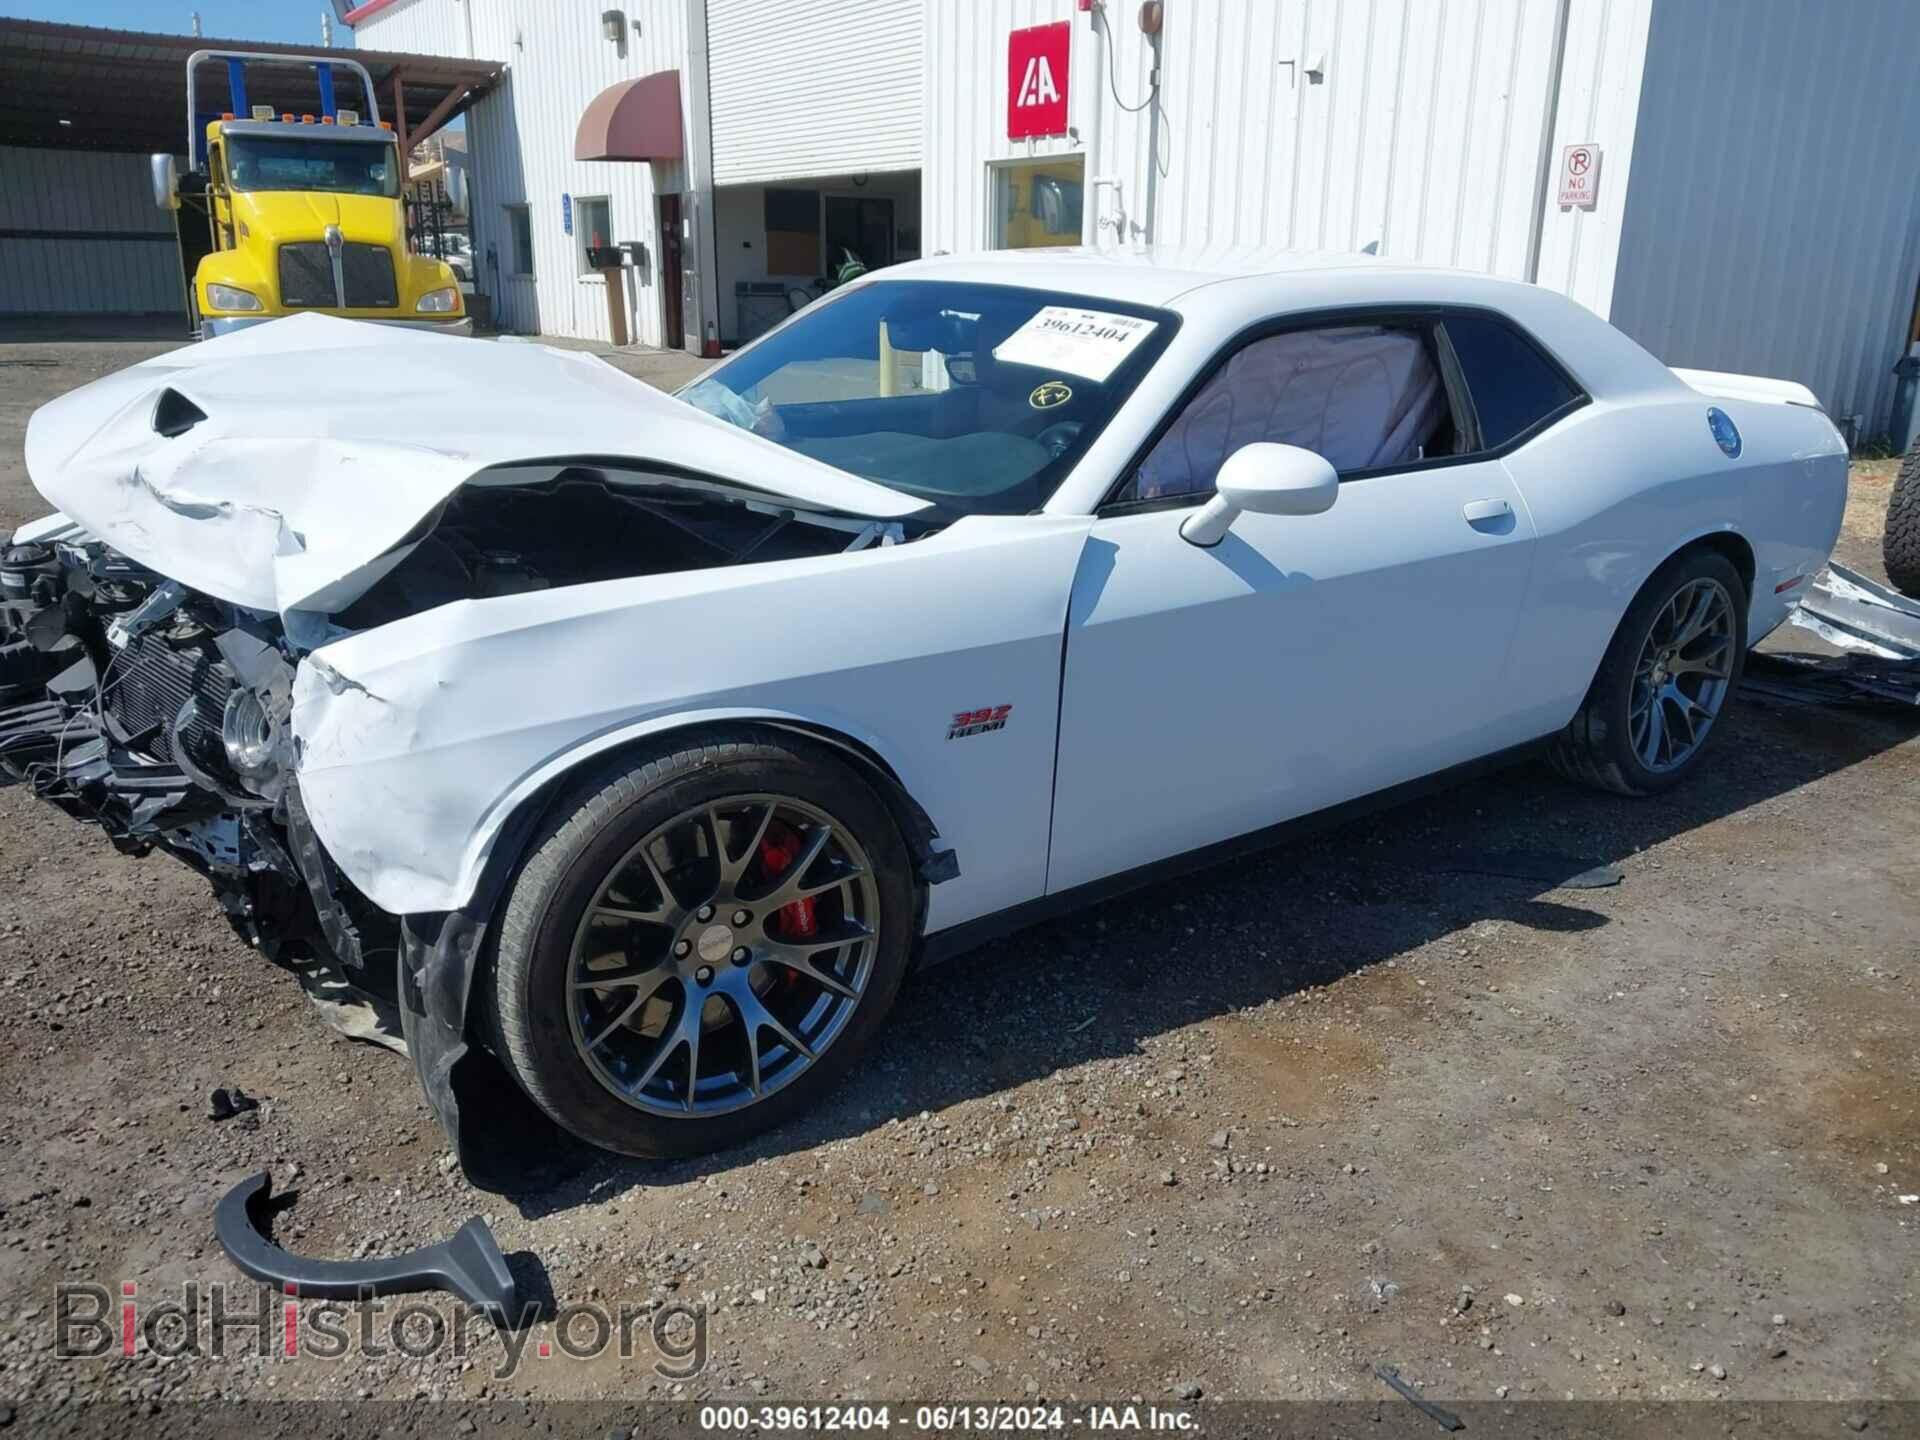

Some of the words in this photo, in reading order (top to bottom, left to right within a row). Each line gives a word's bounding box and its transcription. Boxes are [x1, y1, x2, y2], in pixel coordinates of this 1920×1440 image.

[1568, 177, 1585, 190] NO
[1560, 191, 1592, 201] PARKING
[1043, 318, 1131, 343] 39612404
[952, 704, 1013, 728] 392
[947, 719, 1006, 740] HEMI
